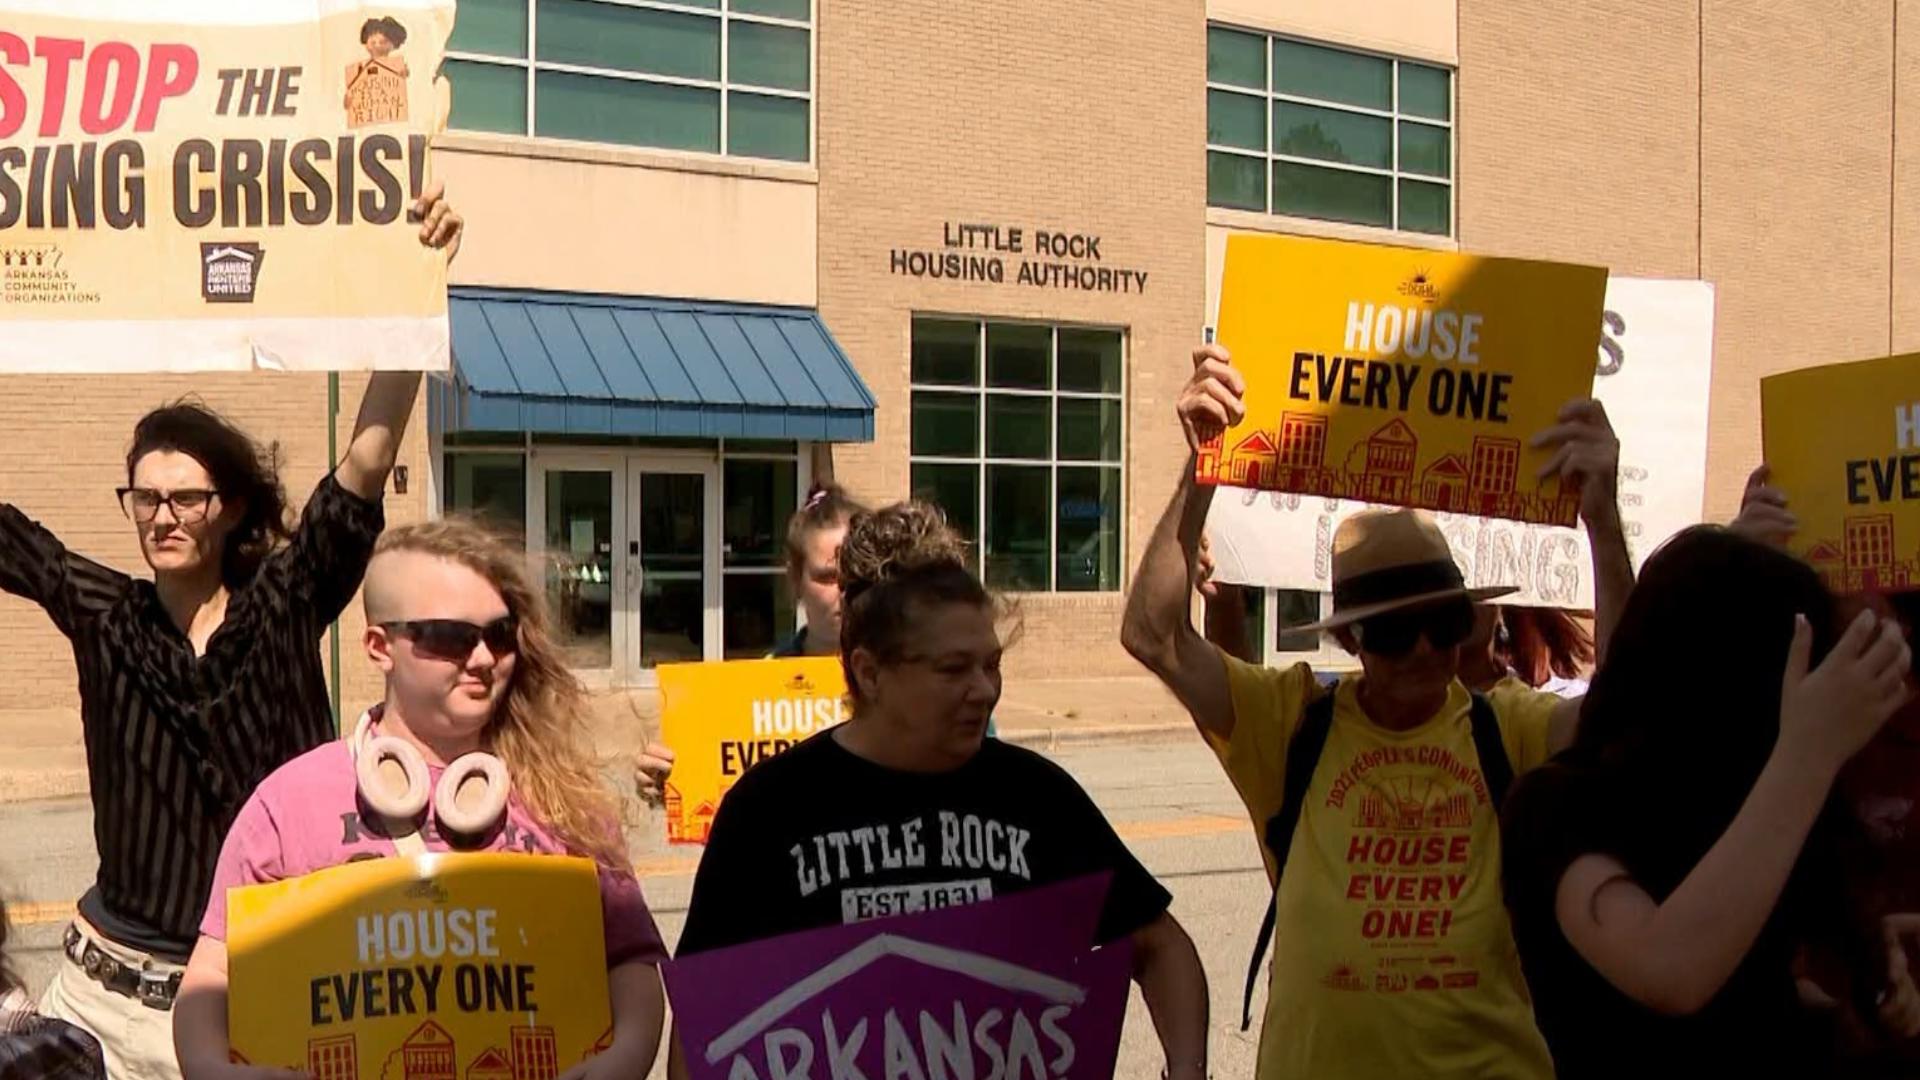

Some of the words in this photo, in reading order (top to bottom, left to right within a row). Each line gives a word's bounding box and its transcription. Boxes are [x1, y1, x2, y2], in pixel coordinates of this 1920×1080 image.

[0, 31, 198, 139] STOP
[216, 66, 302, 117] THE
[173, 134, 426, 228] CRISIS!
[944, 222, 1023, 252] LITTLE
[1035, 231, 1101, 260] ROCK
[5, 270, 69, 279] ARKANSAS
[5, 282, 77, 291] COMMUNITY
[207, 283, 252, 294] UNITED
[891, 249, 1004, 283] HOUSING
[1017, 261, 1148, 294] AUTHORITY
[4, 293, 101, 303] ORGANIZATIONS
[1344, 301, 1483, 364] HOUSE
[1289, 352, 1424, 414] EVERY
[1428, 367, 1513, 423] ONE
[790, 818, 926, 897] LITTLE
[939, 810, 1031, 881] ROCK
[1346, 836, 1471, 866] HOUSE
[1346, 874, 1468, 901] EVERY
[356, 909, 500, 963] HOUSE
[1361, 910, 1453, 939] ONE!
[310, 963, 443, 1026] EVERY
[455, 965, 539, 1013] ONE
